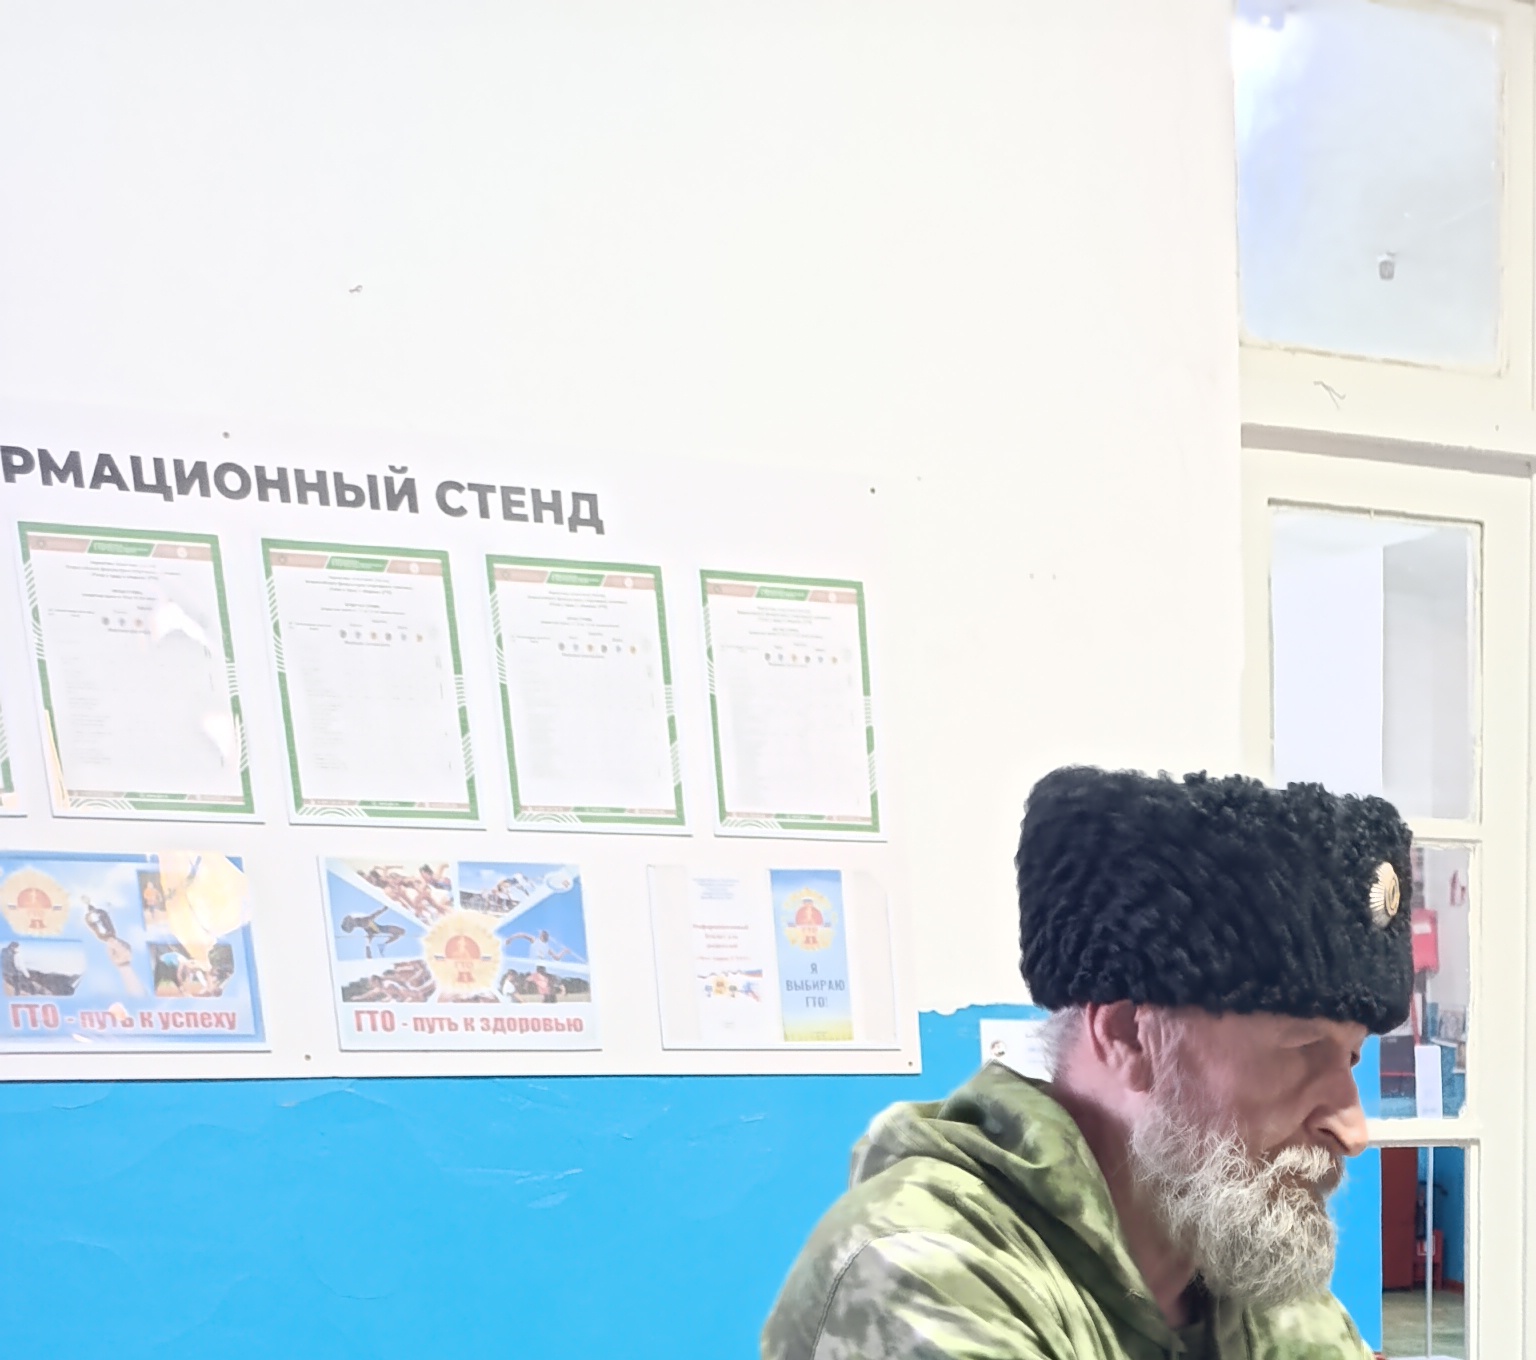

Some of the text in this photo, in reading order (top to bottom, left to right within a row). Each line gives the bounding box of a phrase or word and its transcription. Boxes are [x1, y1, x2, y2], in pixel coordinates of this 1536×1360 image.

[0, 445, 605, 535] РМАЦИОННЫЙ СТЕНД
[809, 962, 818, 974] Я
[785, 979, 845, 991] ВЫБИРАЮ
[11, 1003, 59, 1029] ГТО
[140, 1011, 153, 1028] к
[158, 1011, 236, 1031] успеху
[354, 1010, 395, 1032] ГТО
[413, 1016, 458, 1034] путь
[464, 1016, 474, 1032] к
[480, 1016, 584, 1034] здоровью
